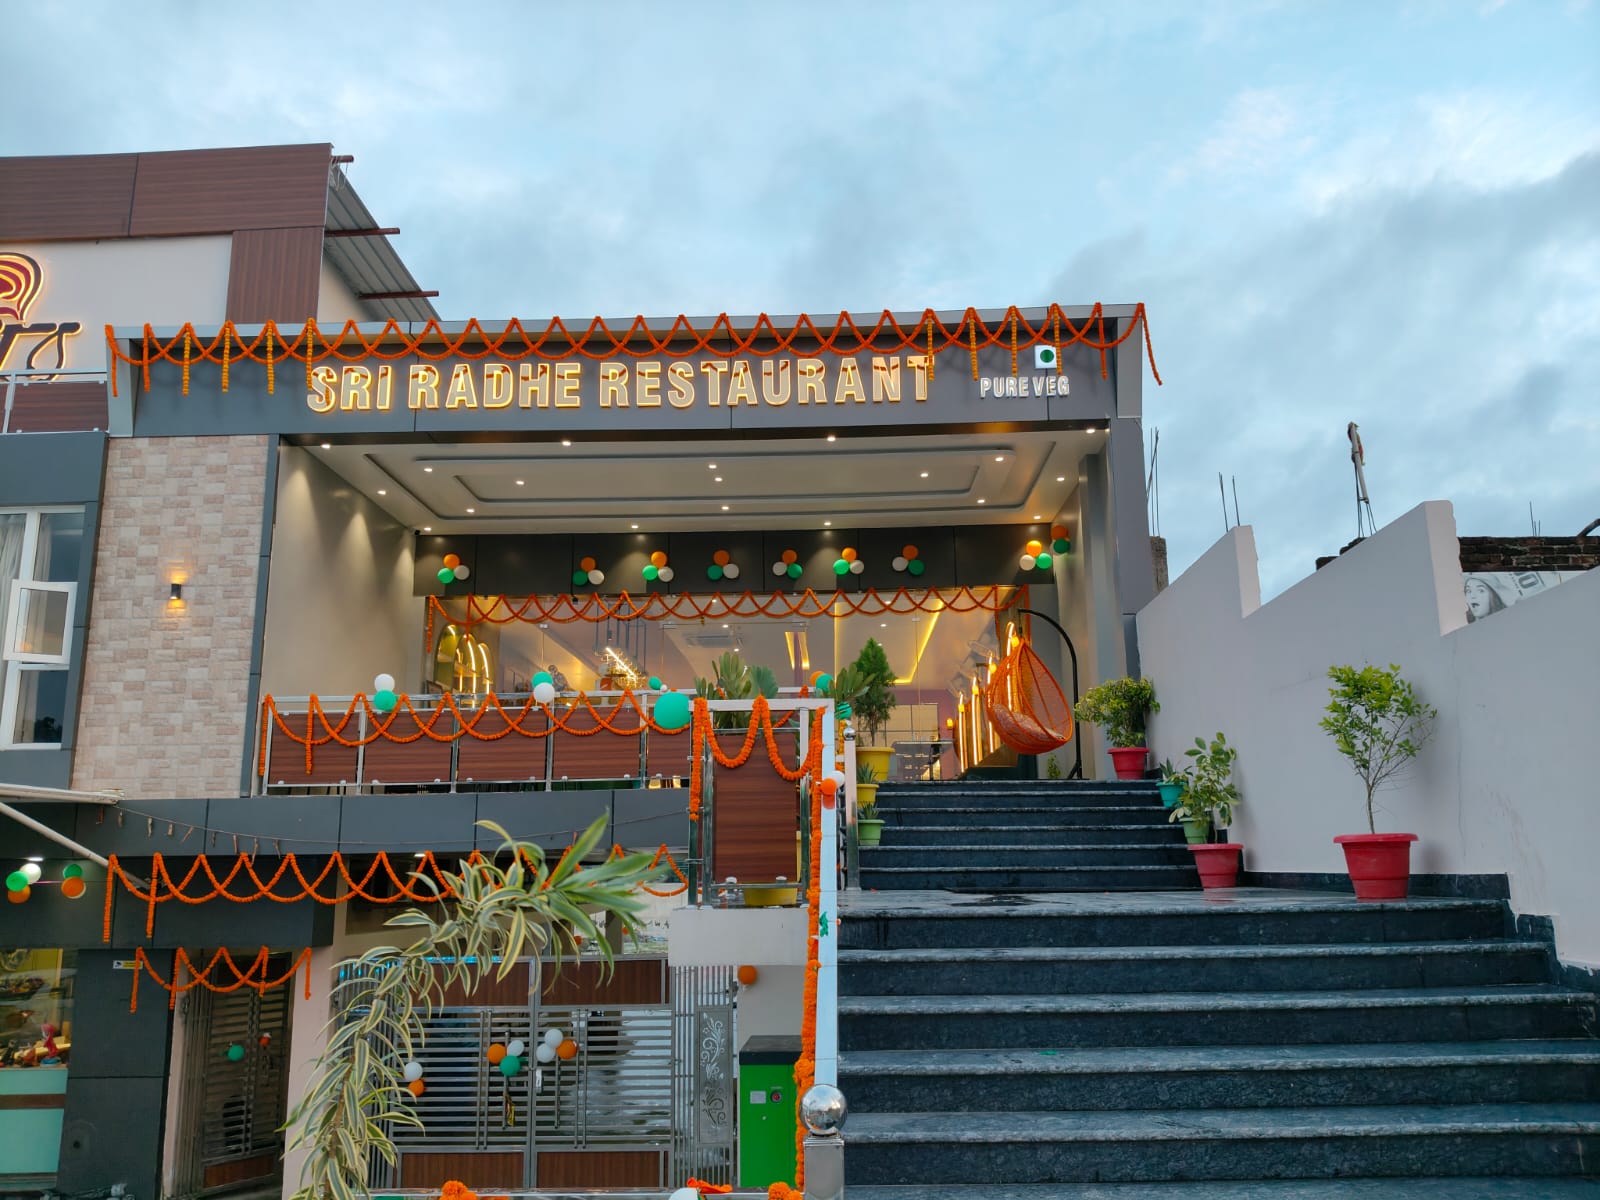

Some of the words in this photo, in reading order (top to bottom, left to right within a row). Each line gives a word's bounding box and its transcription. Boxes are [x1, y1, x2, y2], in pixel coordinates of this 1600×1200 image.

[306, 365, 392, 413] SRI
[408, 361, 583, 410] RADHE
[598, 355, 934, 409] RESTAURANT
[980, 376, 1030, 399] PURE
[1032, 375, 1070, 398] VEG
